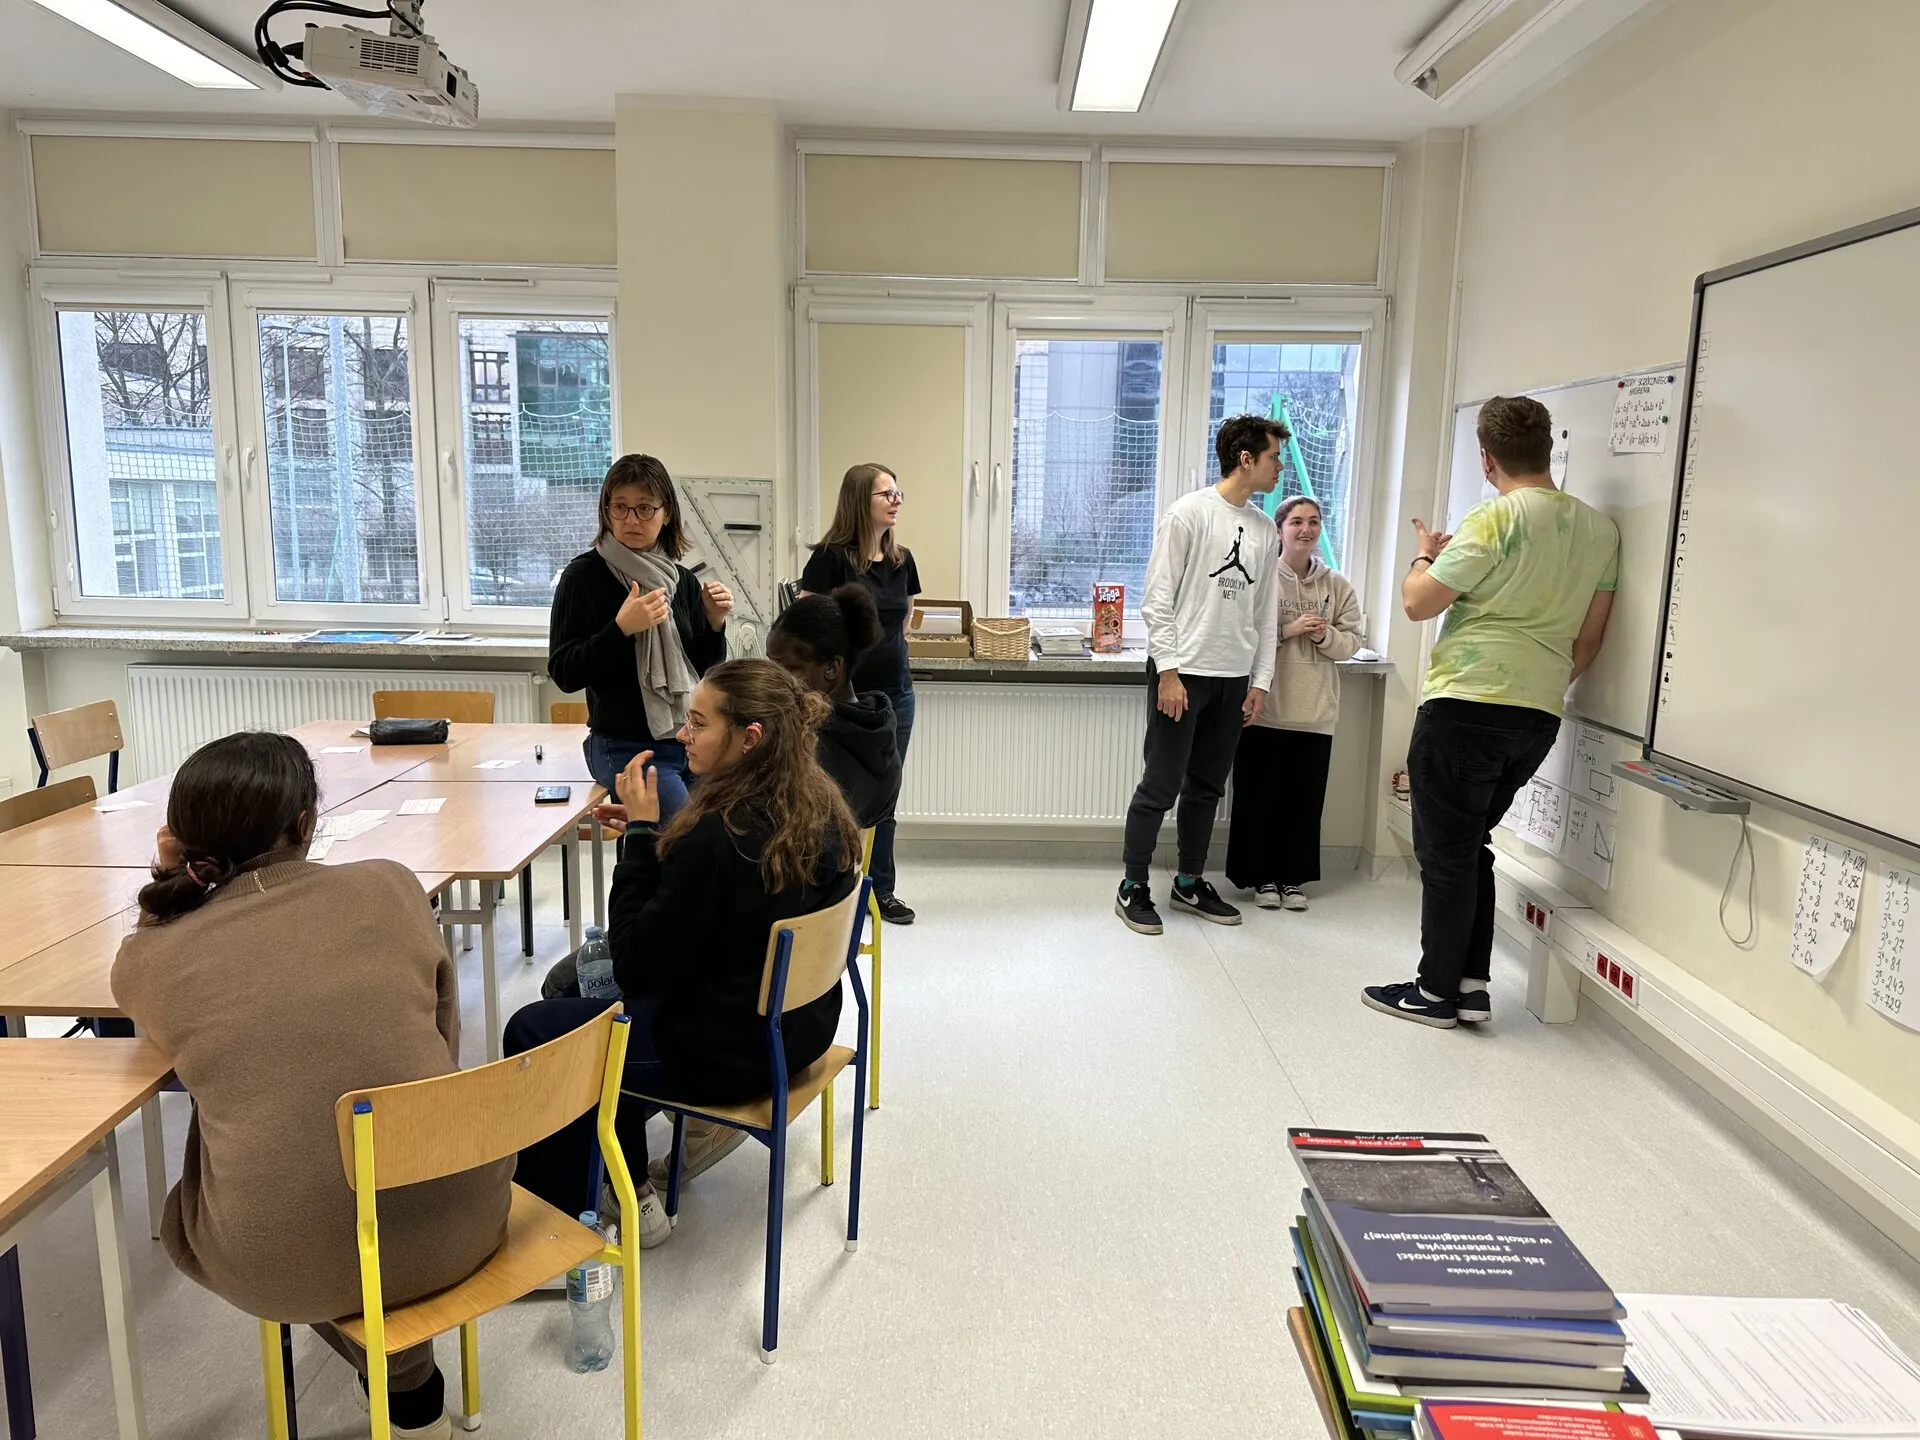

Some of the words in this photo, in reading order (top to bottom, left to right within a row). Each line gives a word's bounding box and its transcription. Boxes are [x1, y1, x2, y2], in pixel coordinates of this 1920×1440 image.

[1218, 577, 1246, 591] BROOKLYN
[1098, 588, 1120, 603] Jenga
[1222, 589, 1237, 601] NETS
[1363, 1231, 1494, 1242] ponadgimnazjalnej?
[1496, 1235, 1536, 1244] szkole
[1416, 1242, 1500, 1252] matematyką
[1396, 1252, 1461, 1262] trudności
[1463, 1254, 1521, 1264] pokonać
[1524, 1257, 1546, 1266] Jak
[1487, 1268, 1513, 1276] Anna
